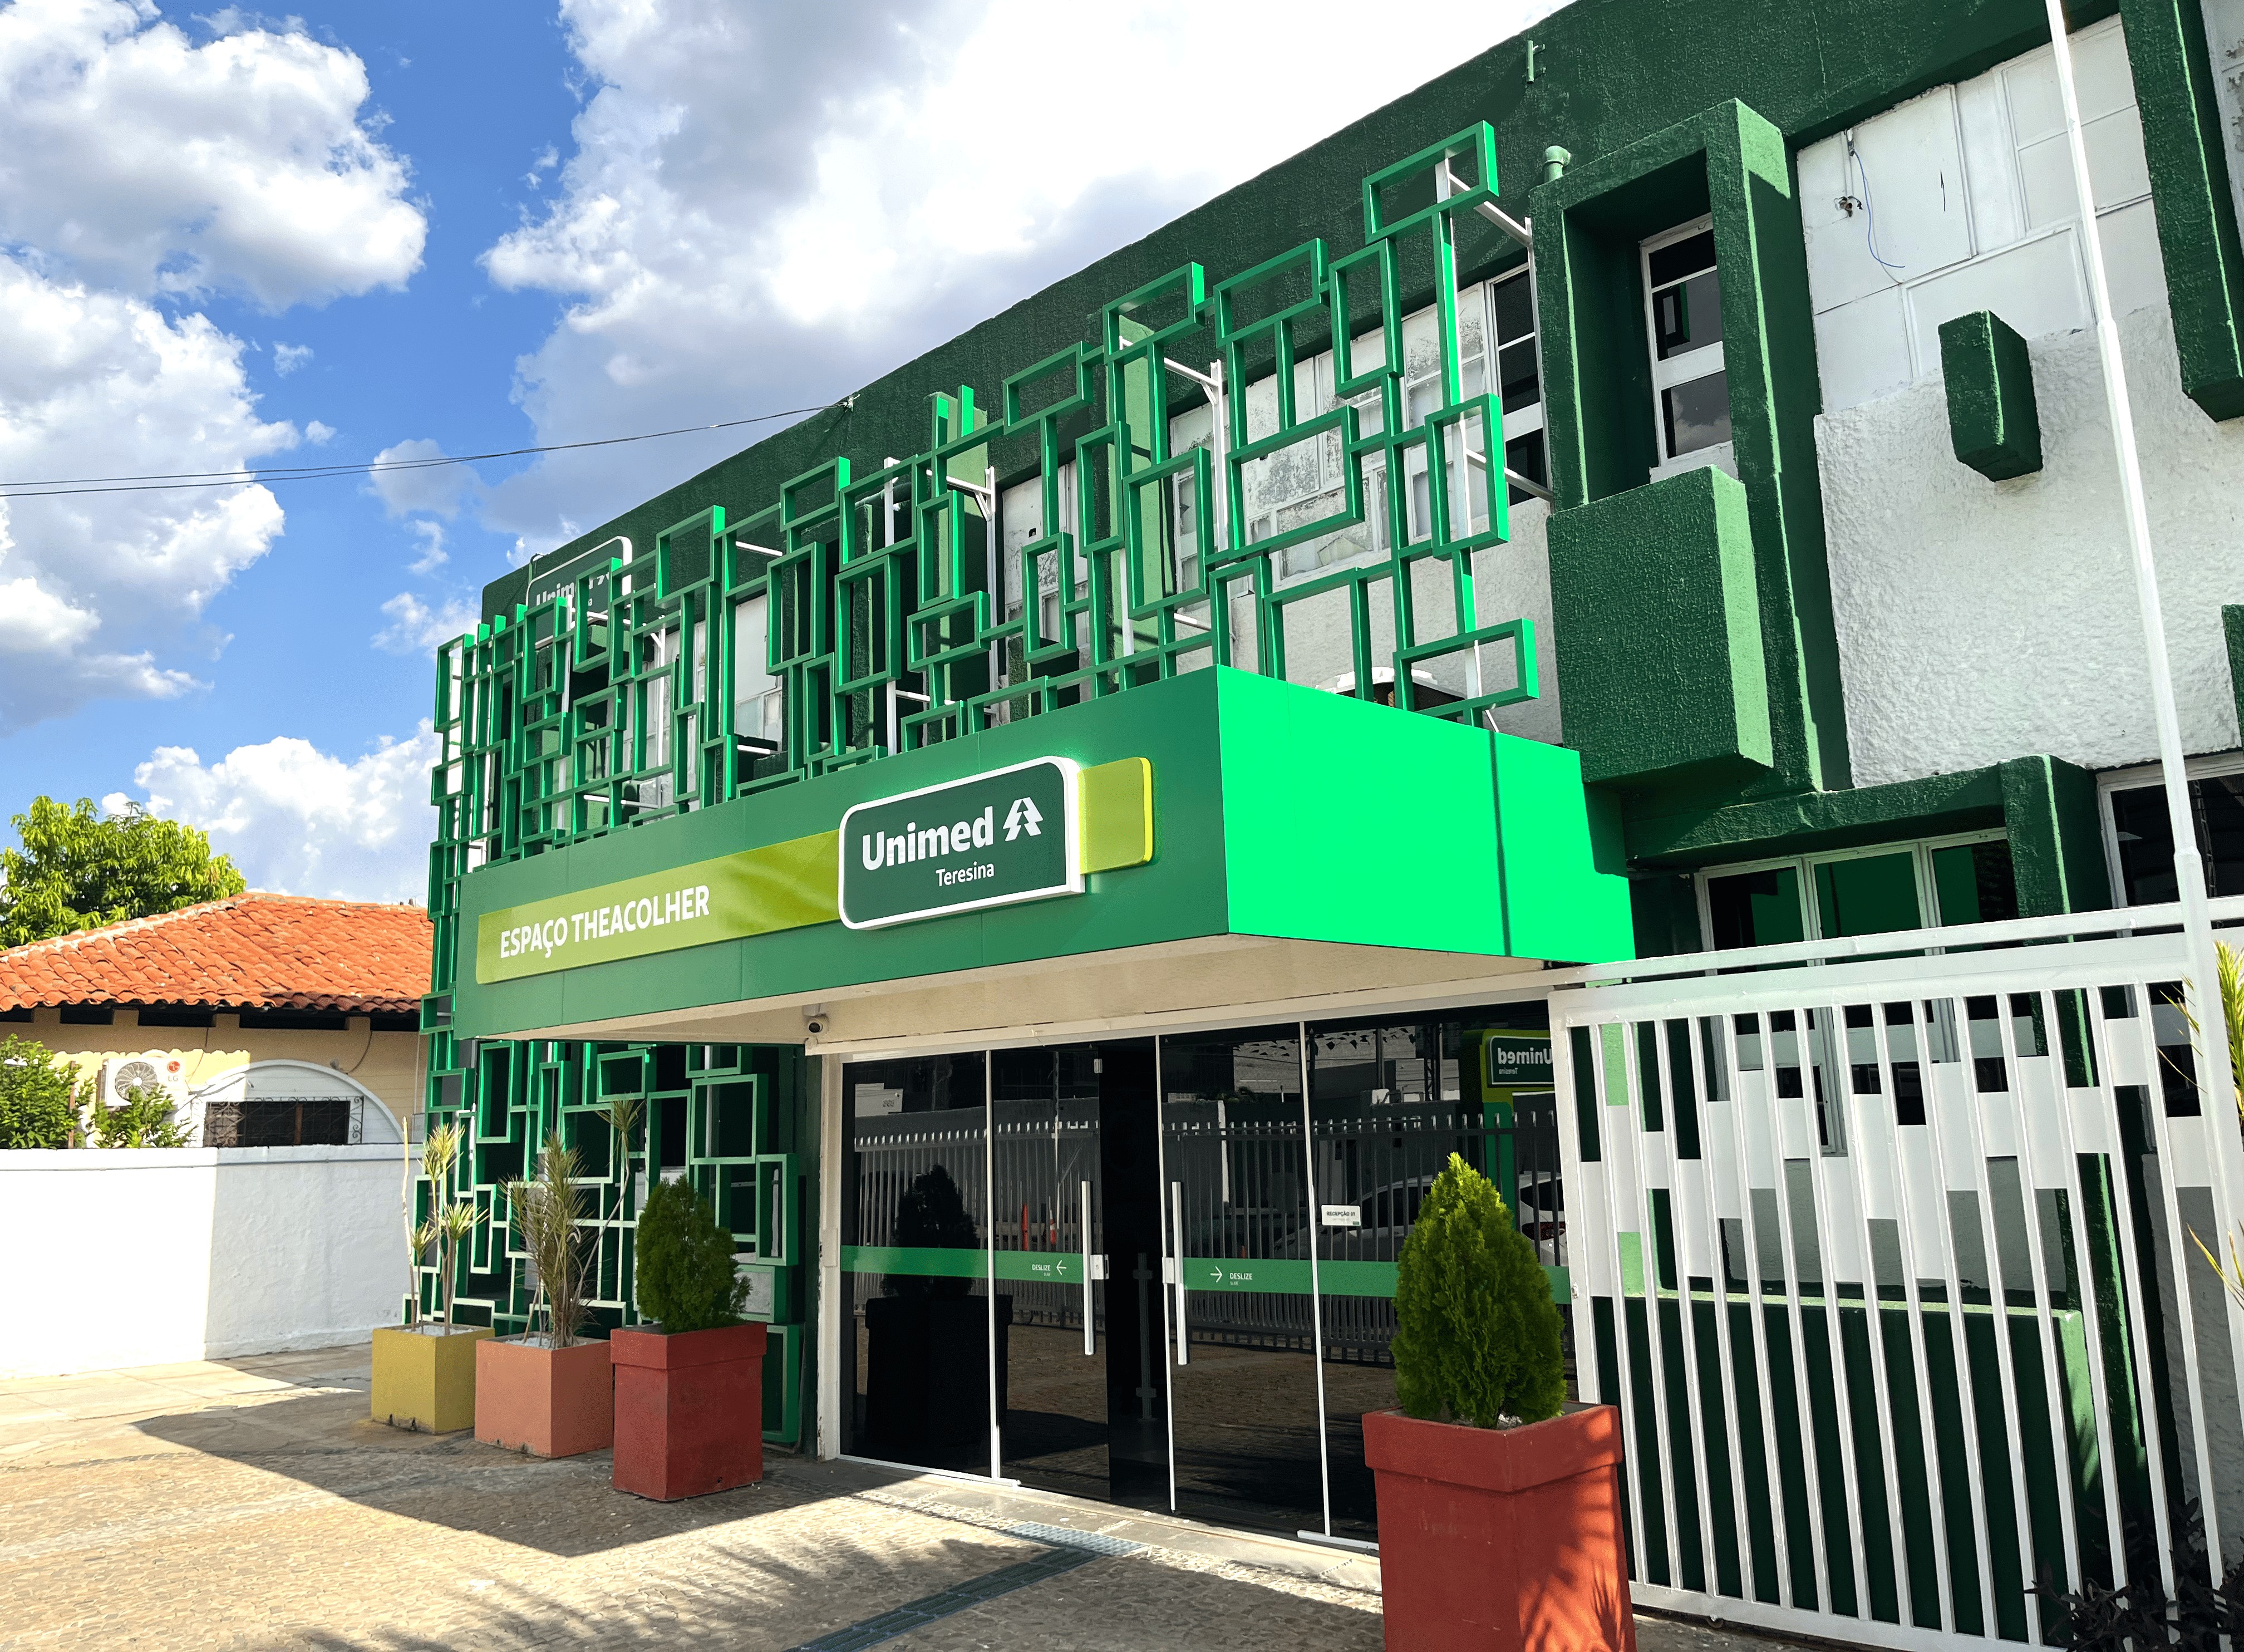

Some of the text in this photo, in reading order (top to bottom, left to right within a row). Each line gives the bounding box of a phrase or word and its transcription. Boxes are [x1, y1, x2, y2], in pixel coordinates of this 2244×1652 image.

[862, 805, 993, 871] Unimed
[935, 861, 995, 887] Teresina
[500, 885, 710, 958] ESPAÇO THEACOLHER
